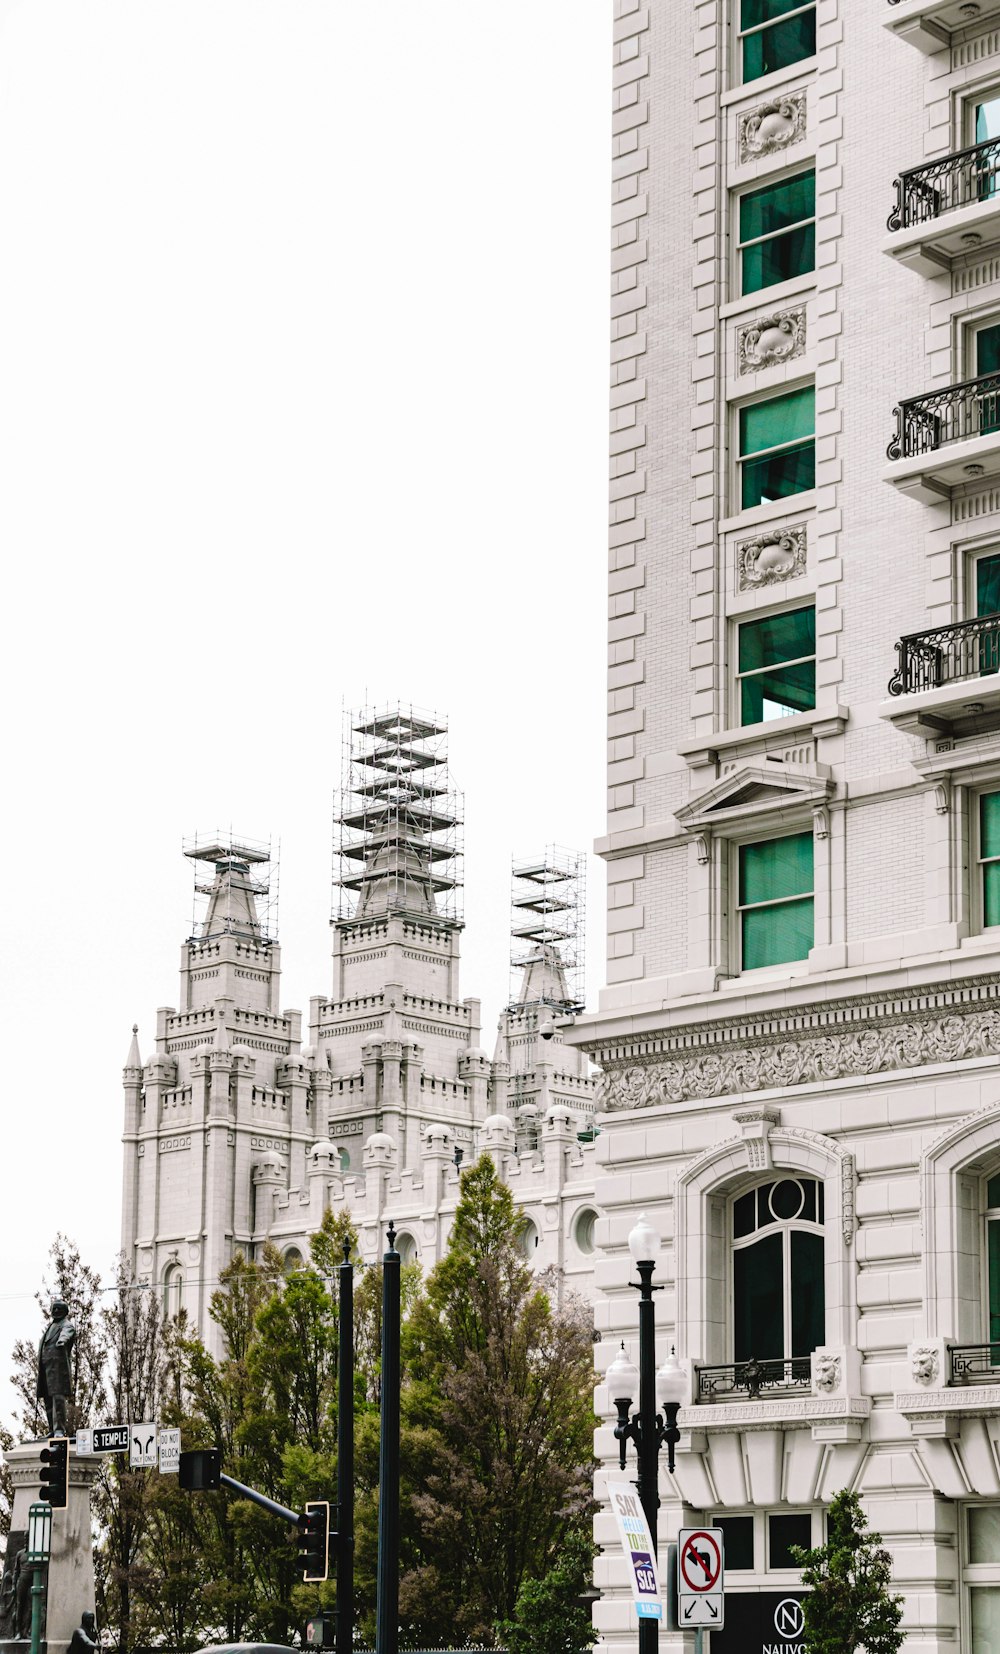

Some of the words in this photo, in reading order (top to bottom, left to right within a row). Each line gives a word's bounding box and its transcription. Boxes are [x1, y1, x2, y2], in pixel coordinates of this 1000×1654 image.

[94, 1434, 99, 1447] S.
[101, 1431, 127, 1447] TEMPLE
[161, 1434, 168, 1444] DO
[169, 1433, 179, 1444] NOT
[131, 1456, 143, 1464] ONLY
[161, 1447, 179, 1459] BLOCK
[615, 1494, 639, 1517] SAY
[622, 1517, 645, 1533] HELLO
[626, 1533, 640, 1550] TO
[638, 1534, 648, 1543] THE
[636, 1569, 656, 1591] SLC
[780, 1606, 799, 1630] N
